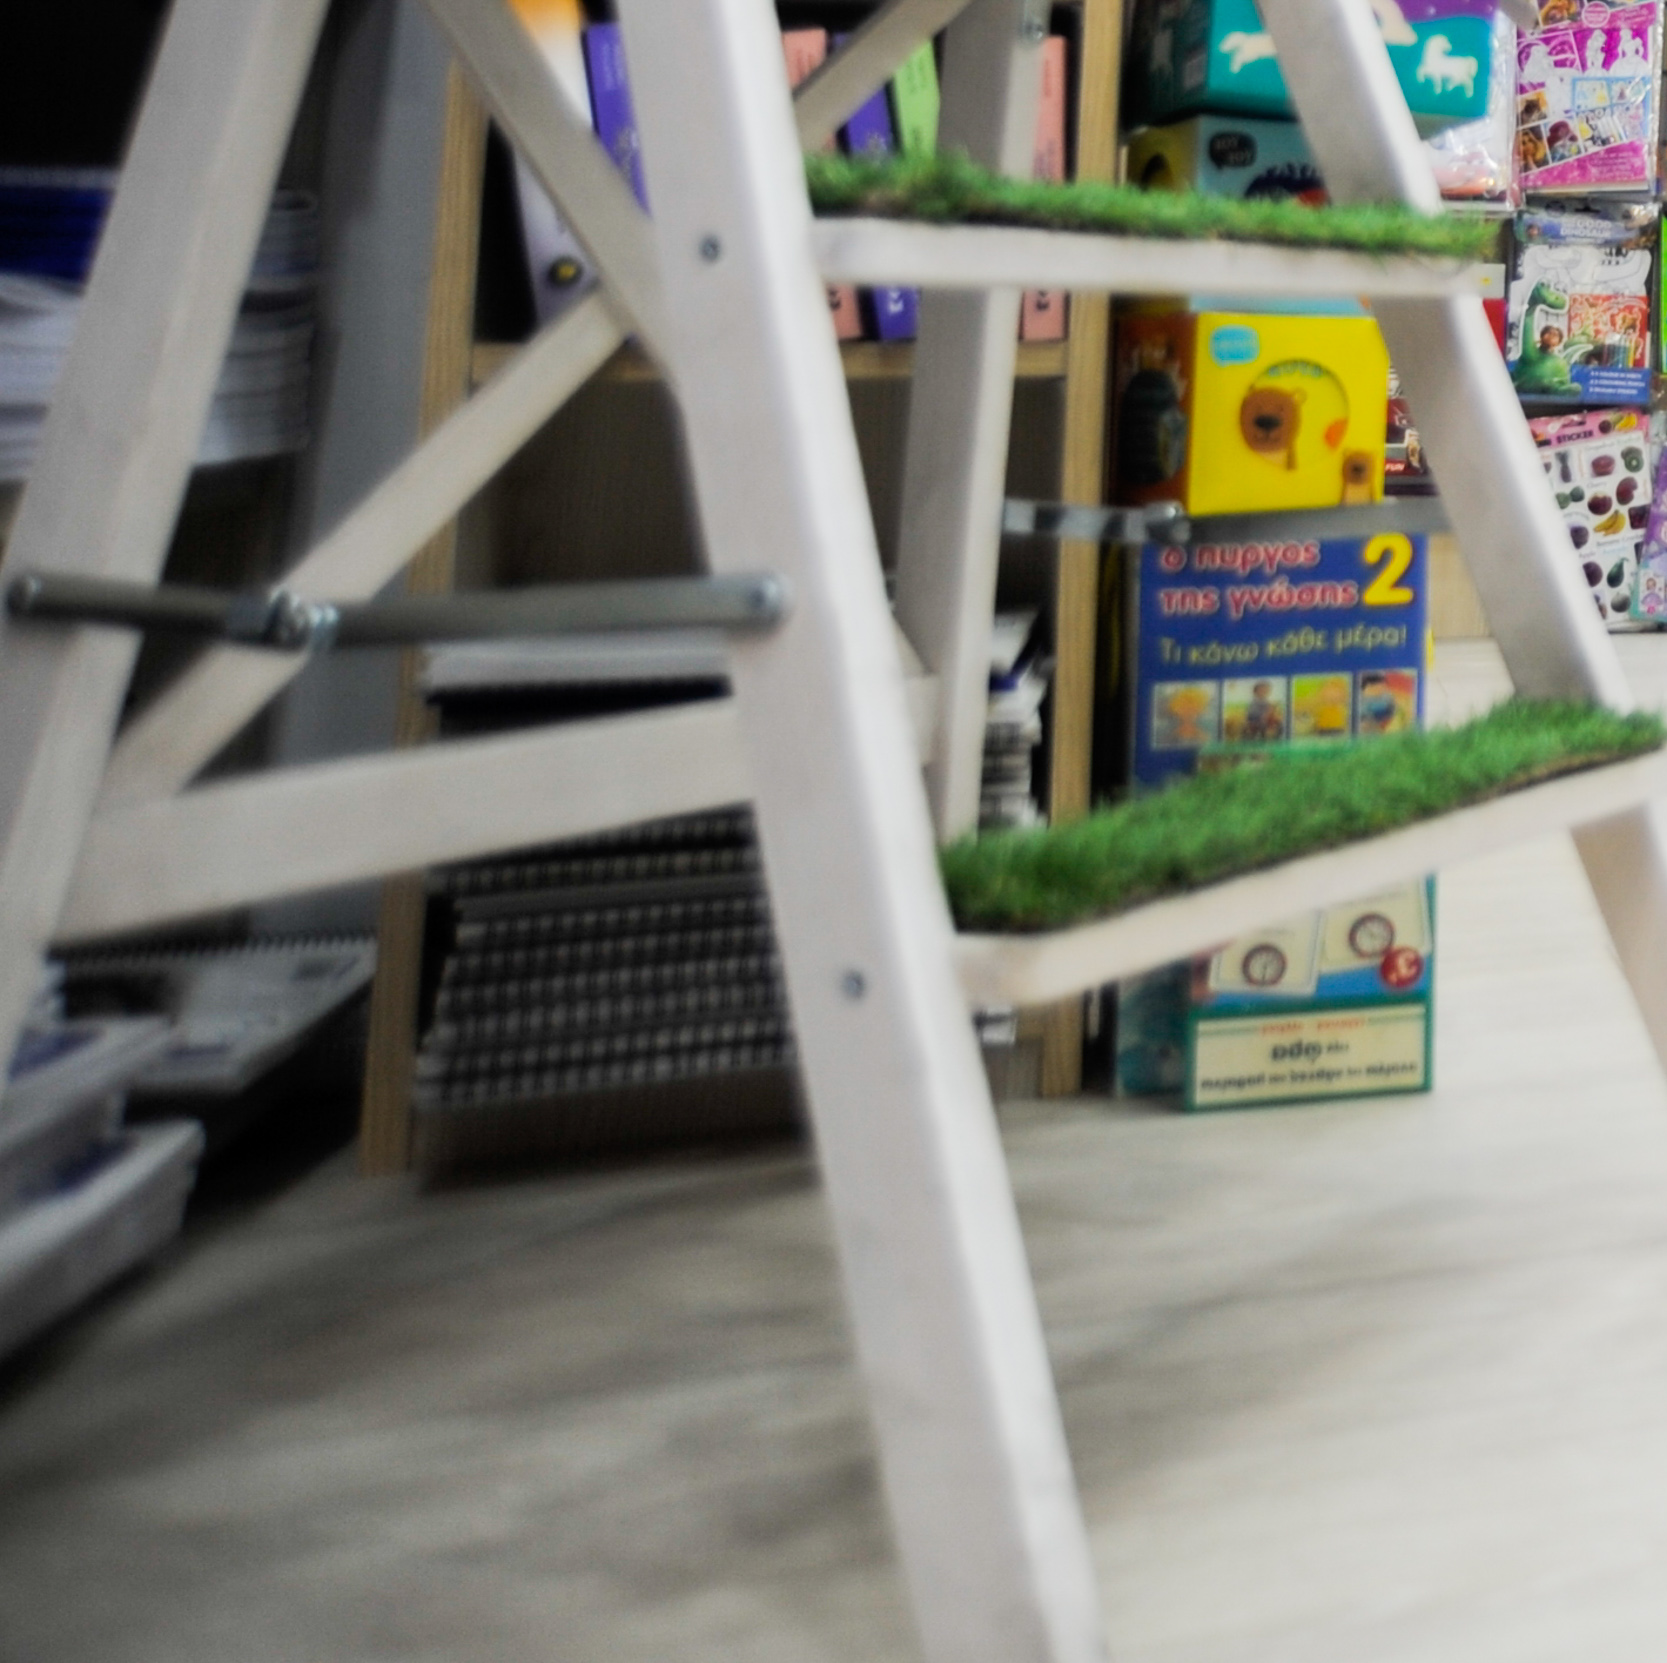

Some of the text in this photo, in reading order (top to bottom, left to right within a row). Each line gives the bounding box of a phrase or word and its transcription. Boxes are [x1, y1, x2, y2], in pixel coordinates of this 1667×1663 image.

[1560, 226, 1612, 238] DINOSAUR
[1556, 429, 1594, 444] STICKER
[1361, 532, 1414, 606] 2
[1159, 574, 1359, 620] της γνώσης
[1187, 638, 1259, 667] κάνω
[1266, 626, 1326, 659] κάθε
[1335, 624, 1408, 655] μέρα!
[1270, 1038, 1324, 1063] ώρα
